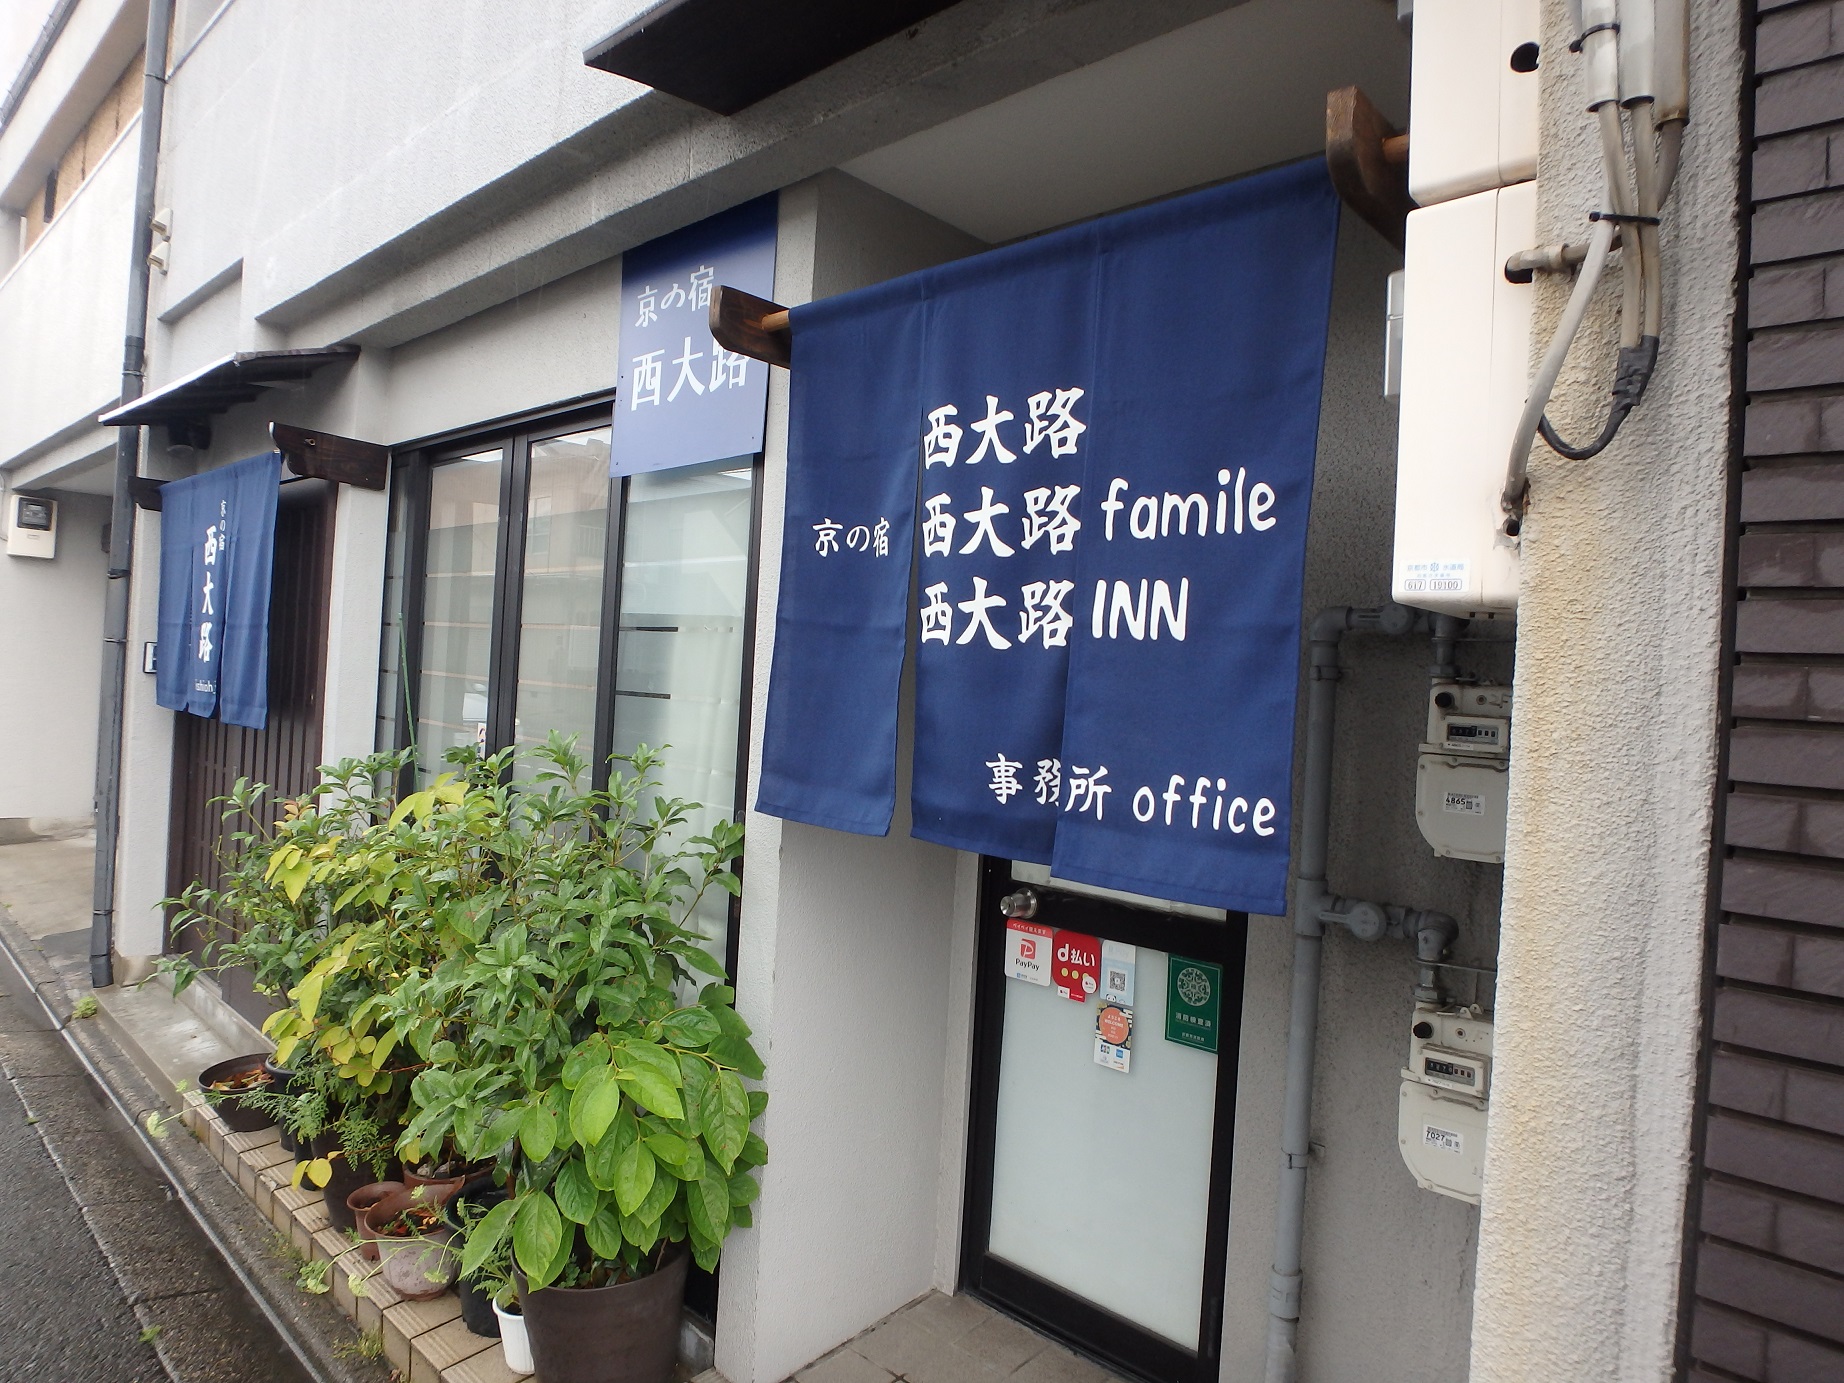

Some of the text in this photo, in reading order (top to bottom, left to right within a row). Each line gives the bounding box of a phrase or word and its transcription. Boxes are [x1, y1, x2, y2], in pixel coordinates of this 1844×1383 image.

[635, 265, 714, 327] 京の宿
[923, 387, 1087, 469] 西大路
[813, 517, 890, 557] 京の宿
[922, 466, 1277, 557] 西大路 famile
[198, 524, 217, 663] 西大路
[1407, 581, 1423, 590] 617
[920, 576, 1189, 650] 西大路 INN
[985, 753, 1276, 837] 事務所 office
[1445, 796, 1466, 805] 4865
[1015, 957, 1040, 971] PayPay
[1057, 943, 1095, 967] d払い
[1426, 1130, 1445, 1141] 7027
